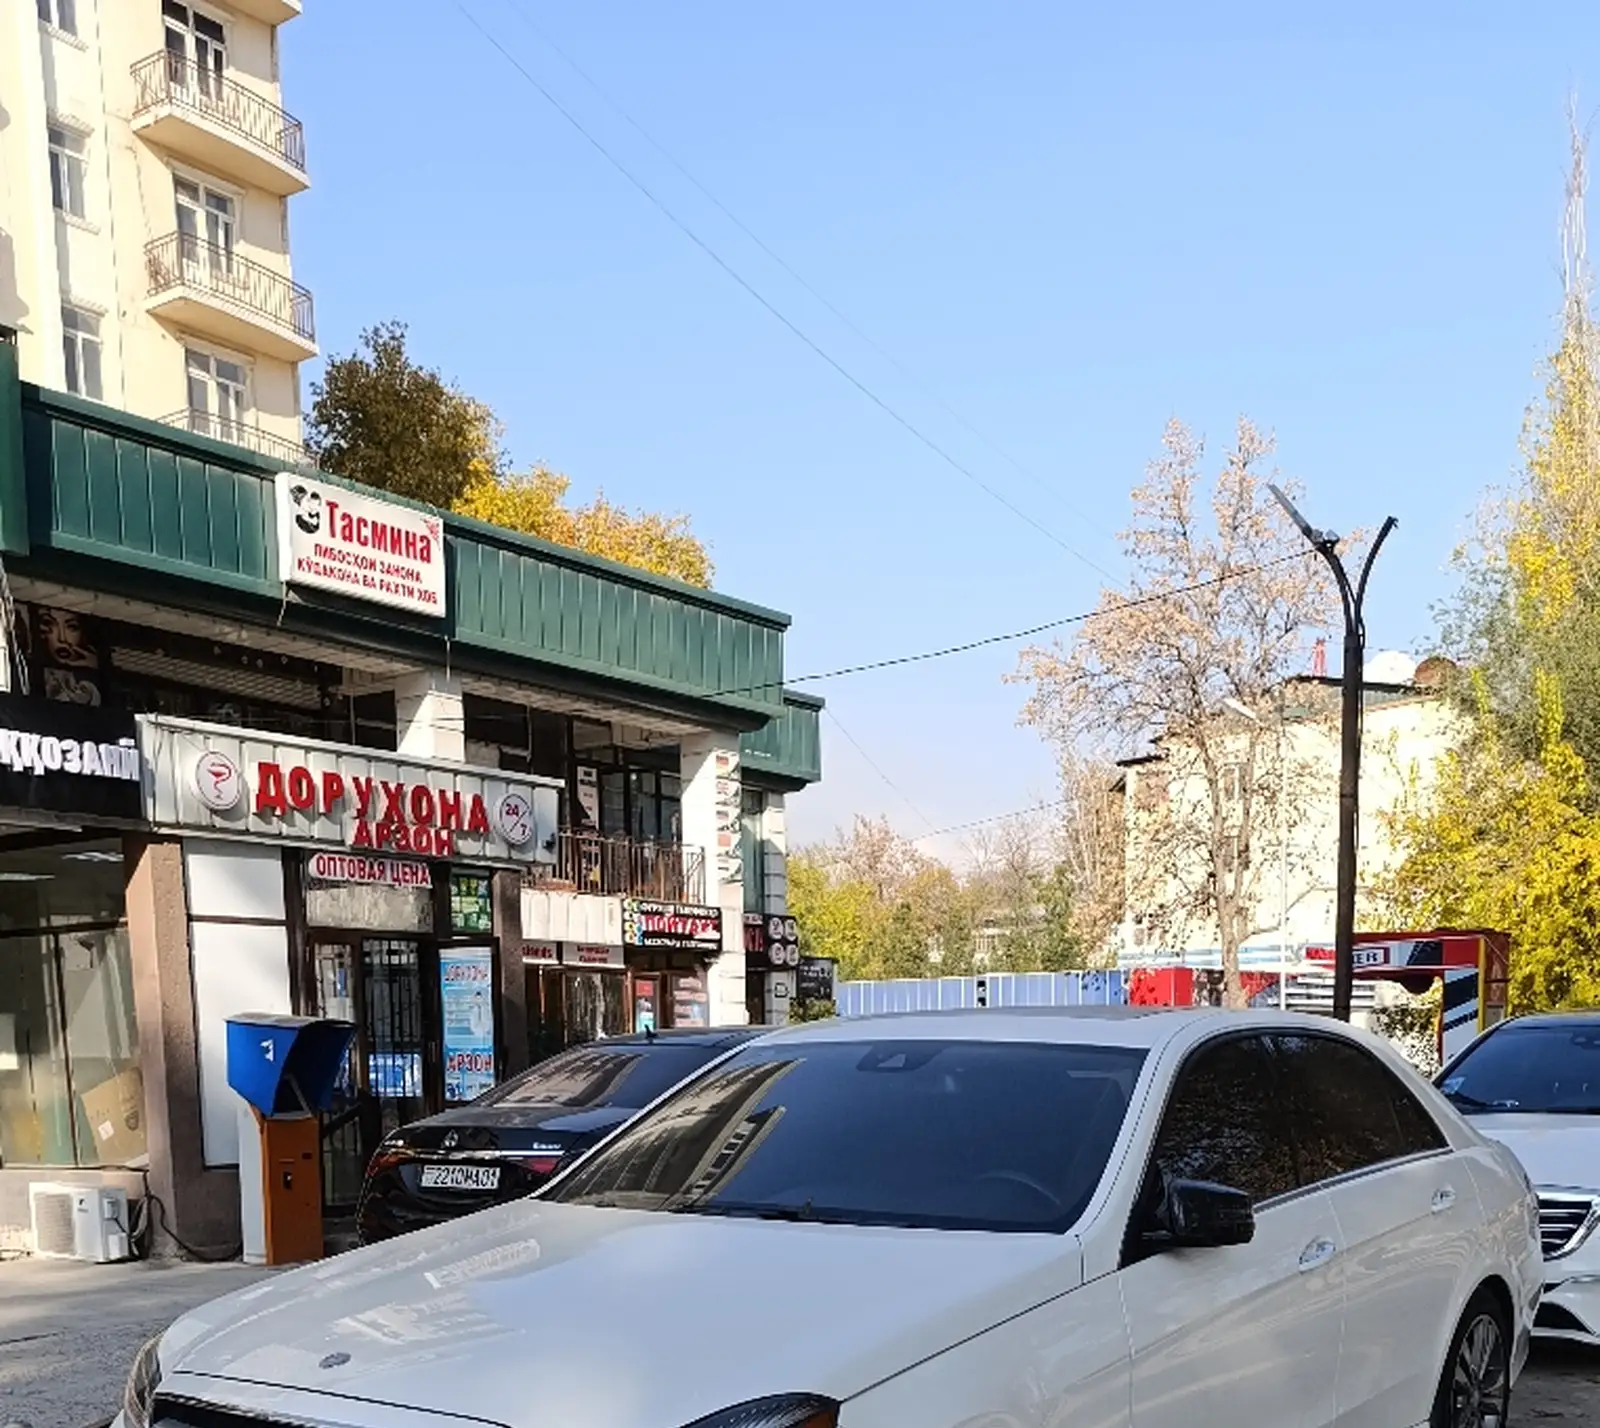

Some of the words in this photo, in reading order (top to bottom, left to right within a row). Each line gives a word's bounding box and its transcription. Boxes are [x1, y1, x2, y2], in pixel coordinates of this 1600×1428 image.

[325, 499, 432, 564] Тасмина
[363, 574, 377, 590] ВА
[255, 761, 490, 834] ДОРУХОНА
[353, 819, 455, 857] АРЗОН
[316, 855, 385, 882] ОПТОВАЯ
[391, 861, 429, 887] ЦЕНА
[446, 1053, 492, 1072] АРЗОН
